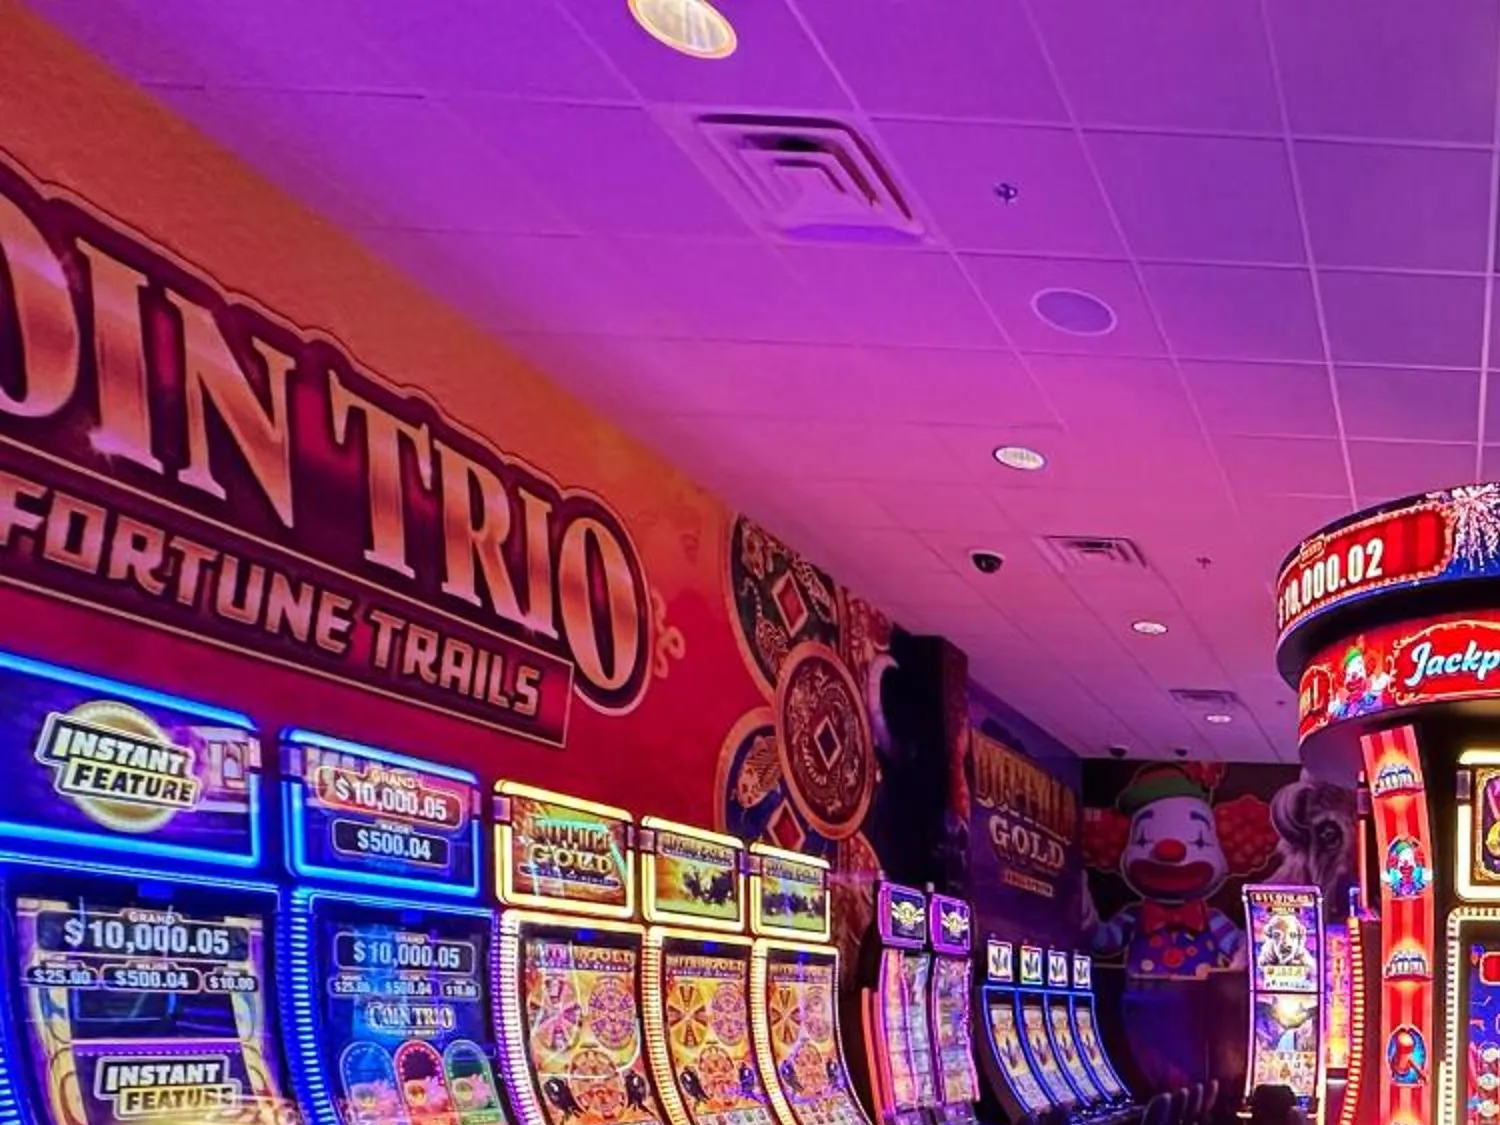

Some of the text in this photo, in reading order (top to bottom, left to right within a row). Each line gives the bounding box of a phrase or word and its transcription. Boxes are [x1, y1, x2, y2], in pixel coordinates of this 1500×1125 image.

[329, 369, 638, 690] TRIO
[0, 473, 540, 716] FORTUNE TRAILS
[52, 727, 185, 775] INSTANT
[72, 763, 194, 801] FEATURE
[357, 829, 433, 860] $500.04
[989, 815, 1065, 870] GOLD
[107, 1063, 220, 1091] INSTANT
[126, 1085, 233, 1109] FEATURE
